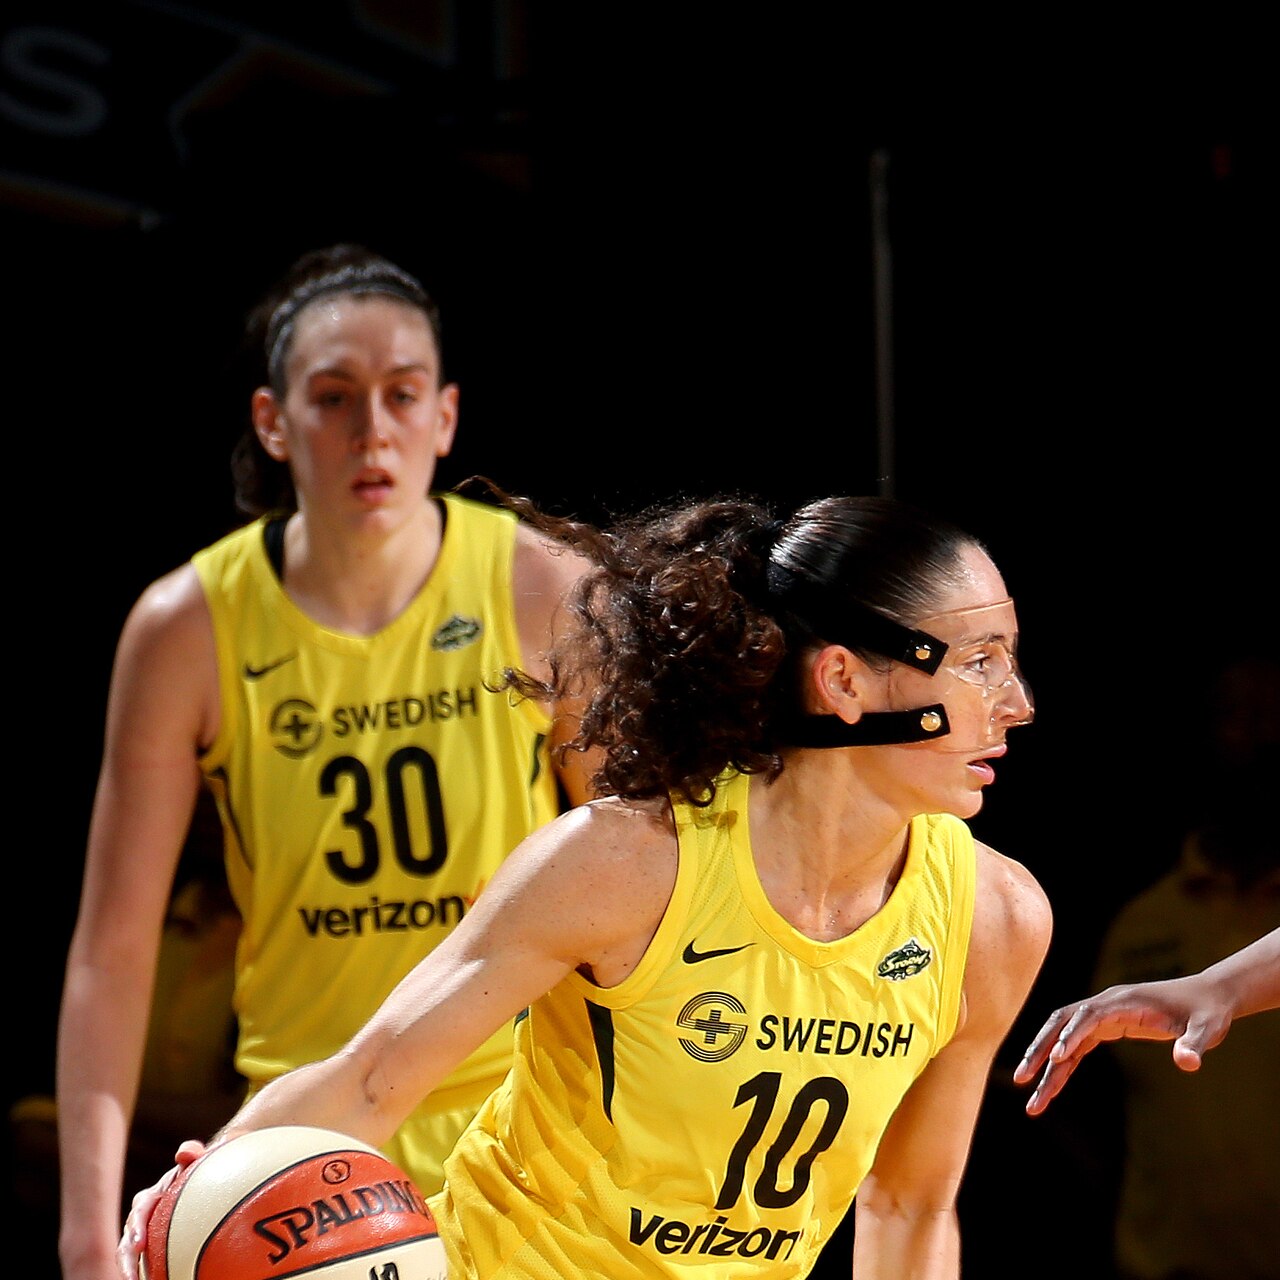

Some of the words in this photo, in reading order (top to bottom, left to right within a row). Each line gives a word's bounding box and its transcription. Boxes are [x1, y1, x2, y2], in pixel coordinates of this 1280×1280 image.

[333, 687, 478, 737] SWEDISH
[318, 746, 449, 886] 30
[299, 895, 465, 939] verizon
[756, 1014, 914, 1058] SWEDISH
[714, 1071, 849, 1210] 10
[629, 1207, 800, 1261] verizon
